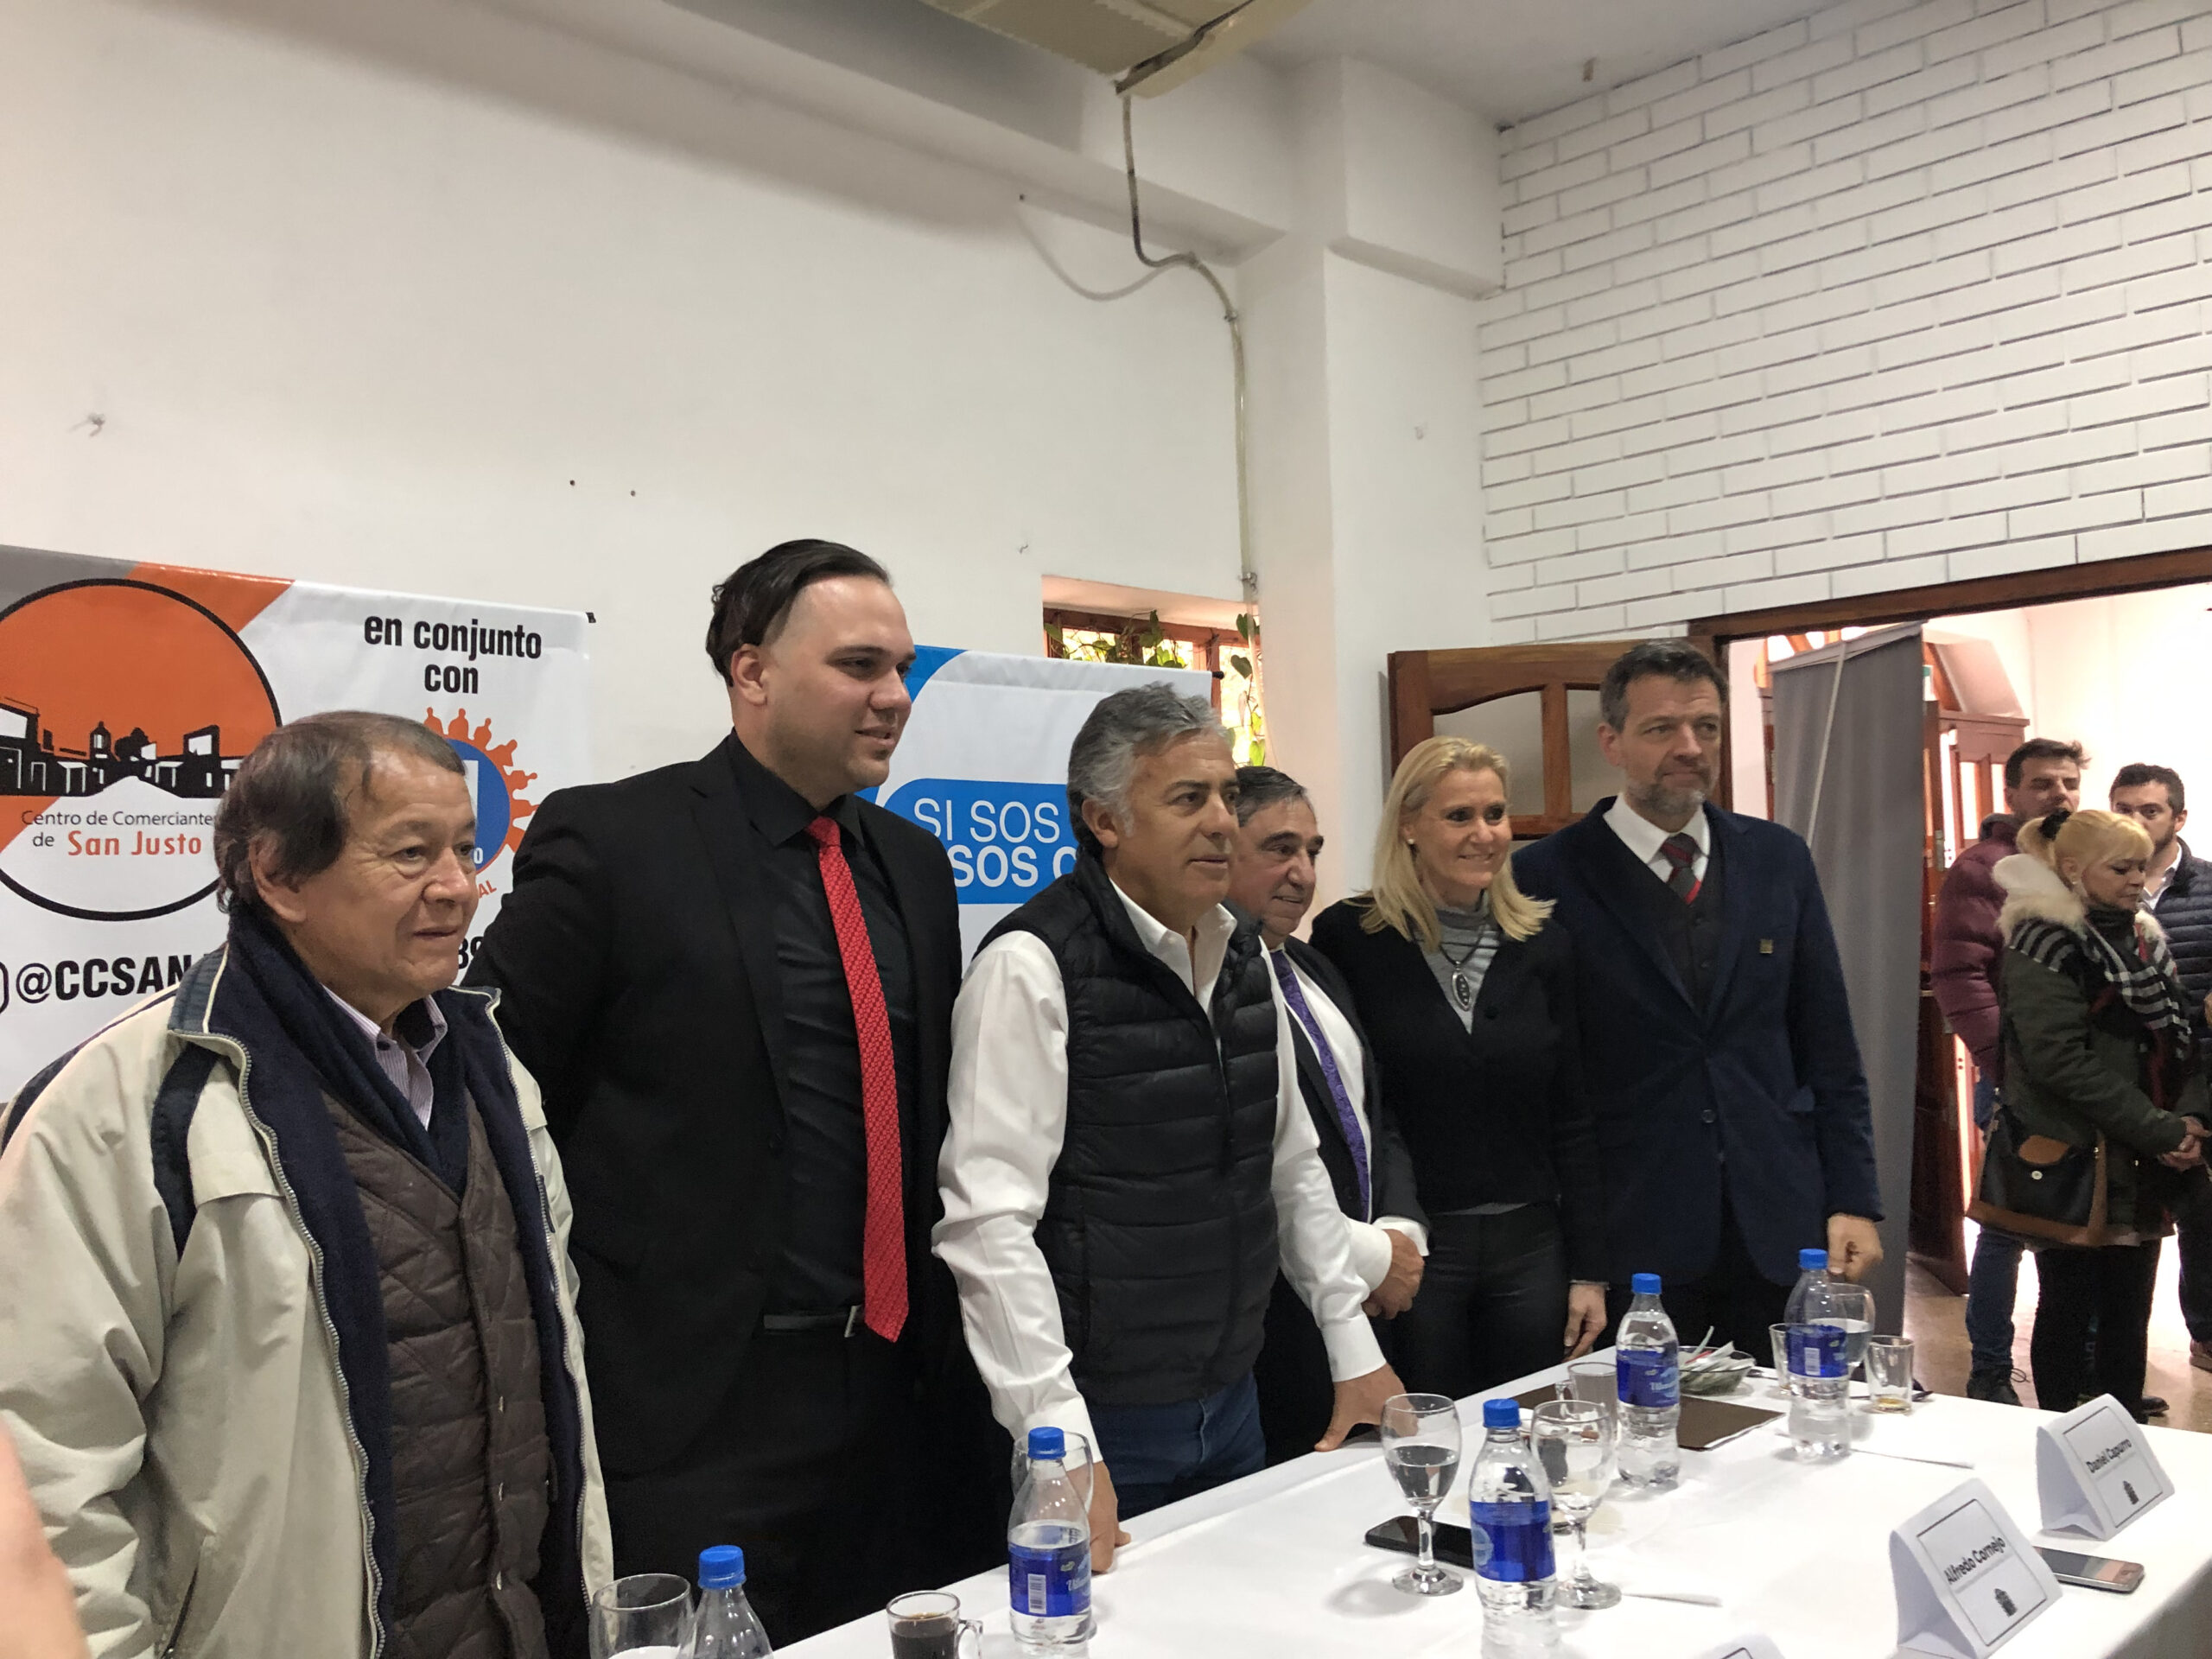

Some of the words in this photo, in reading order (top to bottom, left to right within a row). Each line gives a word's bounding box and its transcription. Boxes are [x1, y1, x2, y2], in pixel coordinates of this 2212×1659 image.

[364, 616, 403, 646] en
[413, 619, 542, 661] conjunto
[424, 664, 479, 695] con
[22, 810, 82, 825] Centro
[86, 810, 108, 825] de
[112, 810, 217, 826] Comerciante
[914, 798, 953, 841] SI
[969, 800, 1060, 843] SOS
[32, 831, 55, 847] de
[67, 830, 120, 856] San
[131, 830, 202, 855] Justo
[947, 844, 1039, 887] SOS
[16, 954, 192, 1004] @CCSAN
[1943, 1556, 1977, 1586] Alfredo
[1972, 1535, 2005, 1564] Cornejo
